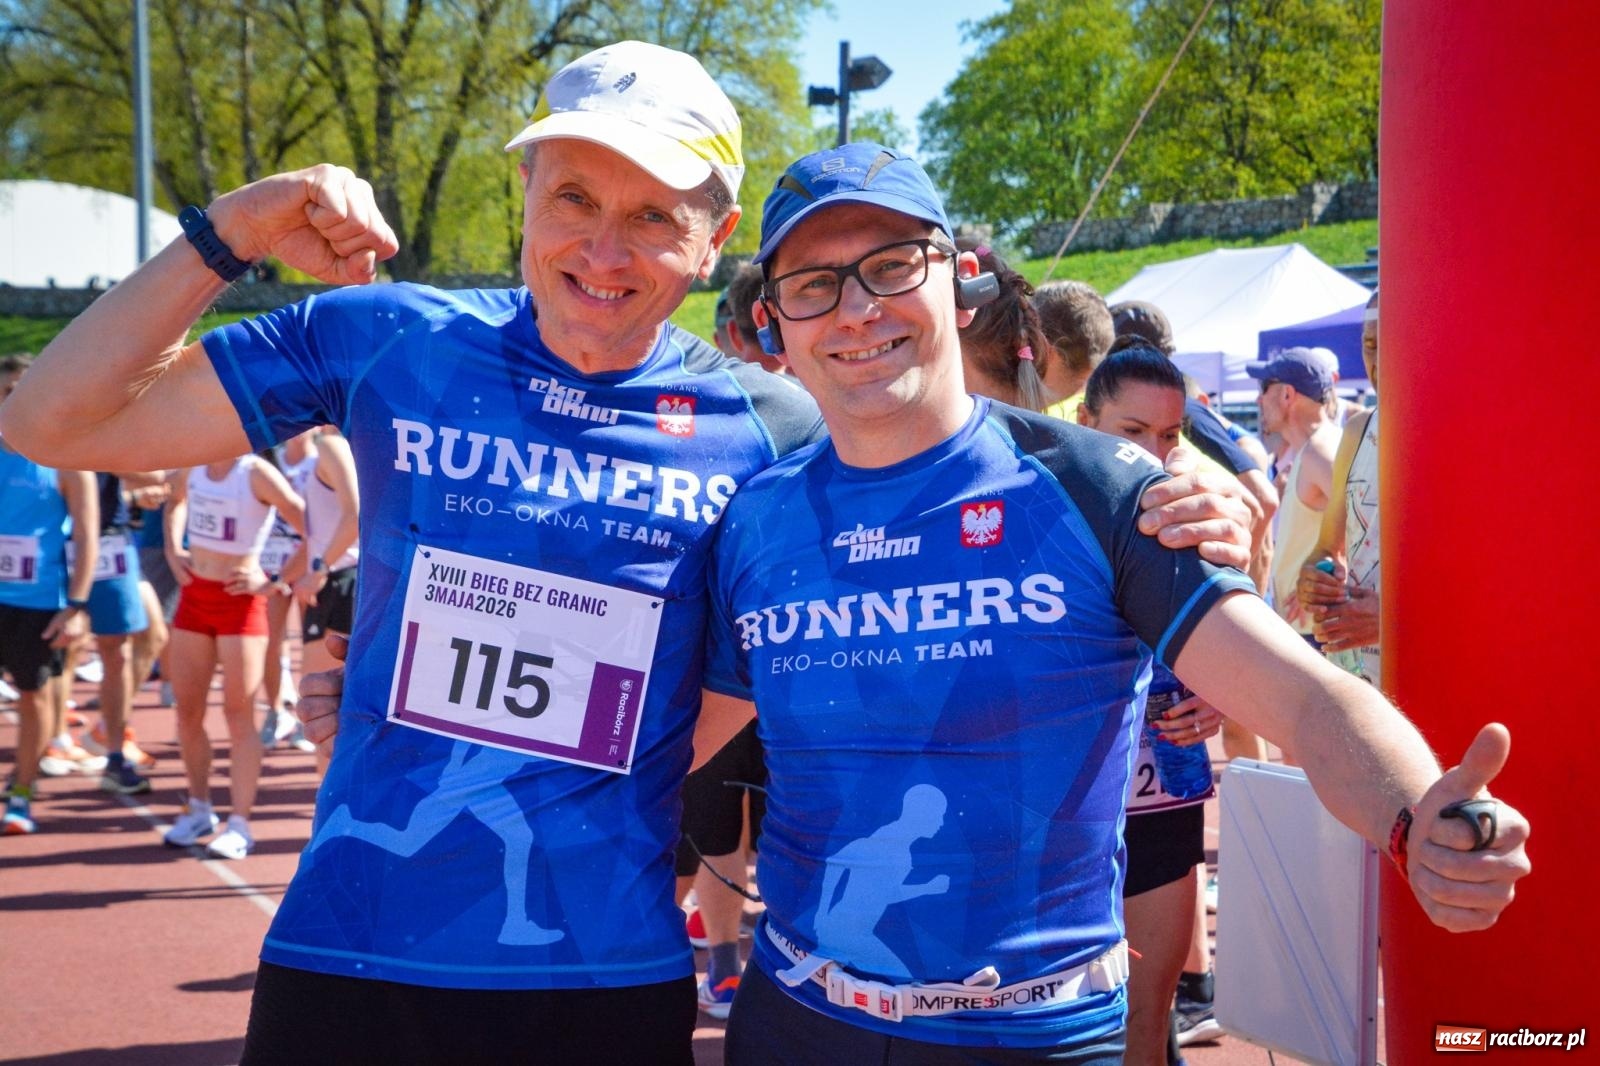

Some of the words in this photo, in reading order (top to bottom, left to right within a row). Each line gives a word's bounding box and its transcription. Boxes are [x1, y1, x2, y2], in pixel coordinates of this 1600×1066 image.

[660, 383, 698, 393] POLAND
[392, 418, 738, 525] RUNNERS
[601, 518, 672, 549] TEAM
[424, 584, 517, 619] 3MAJA2026
[428, 563, 467, 587] XVIII
[470, 572, 510, 596] BIEG
[513, 581, 544, 603] BEZ
[546, 588, 608, 618] GRANIC
[735, 573, 1067, 651] RUNNERS
[914, 638, 993, 663] TEAM
[448, 637, 554, 719] 115
[613, 692, 629, 736] Racibórz
